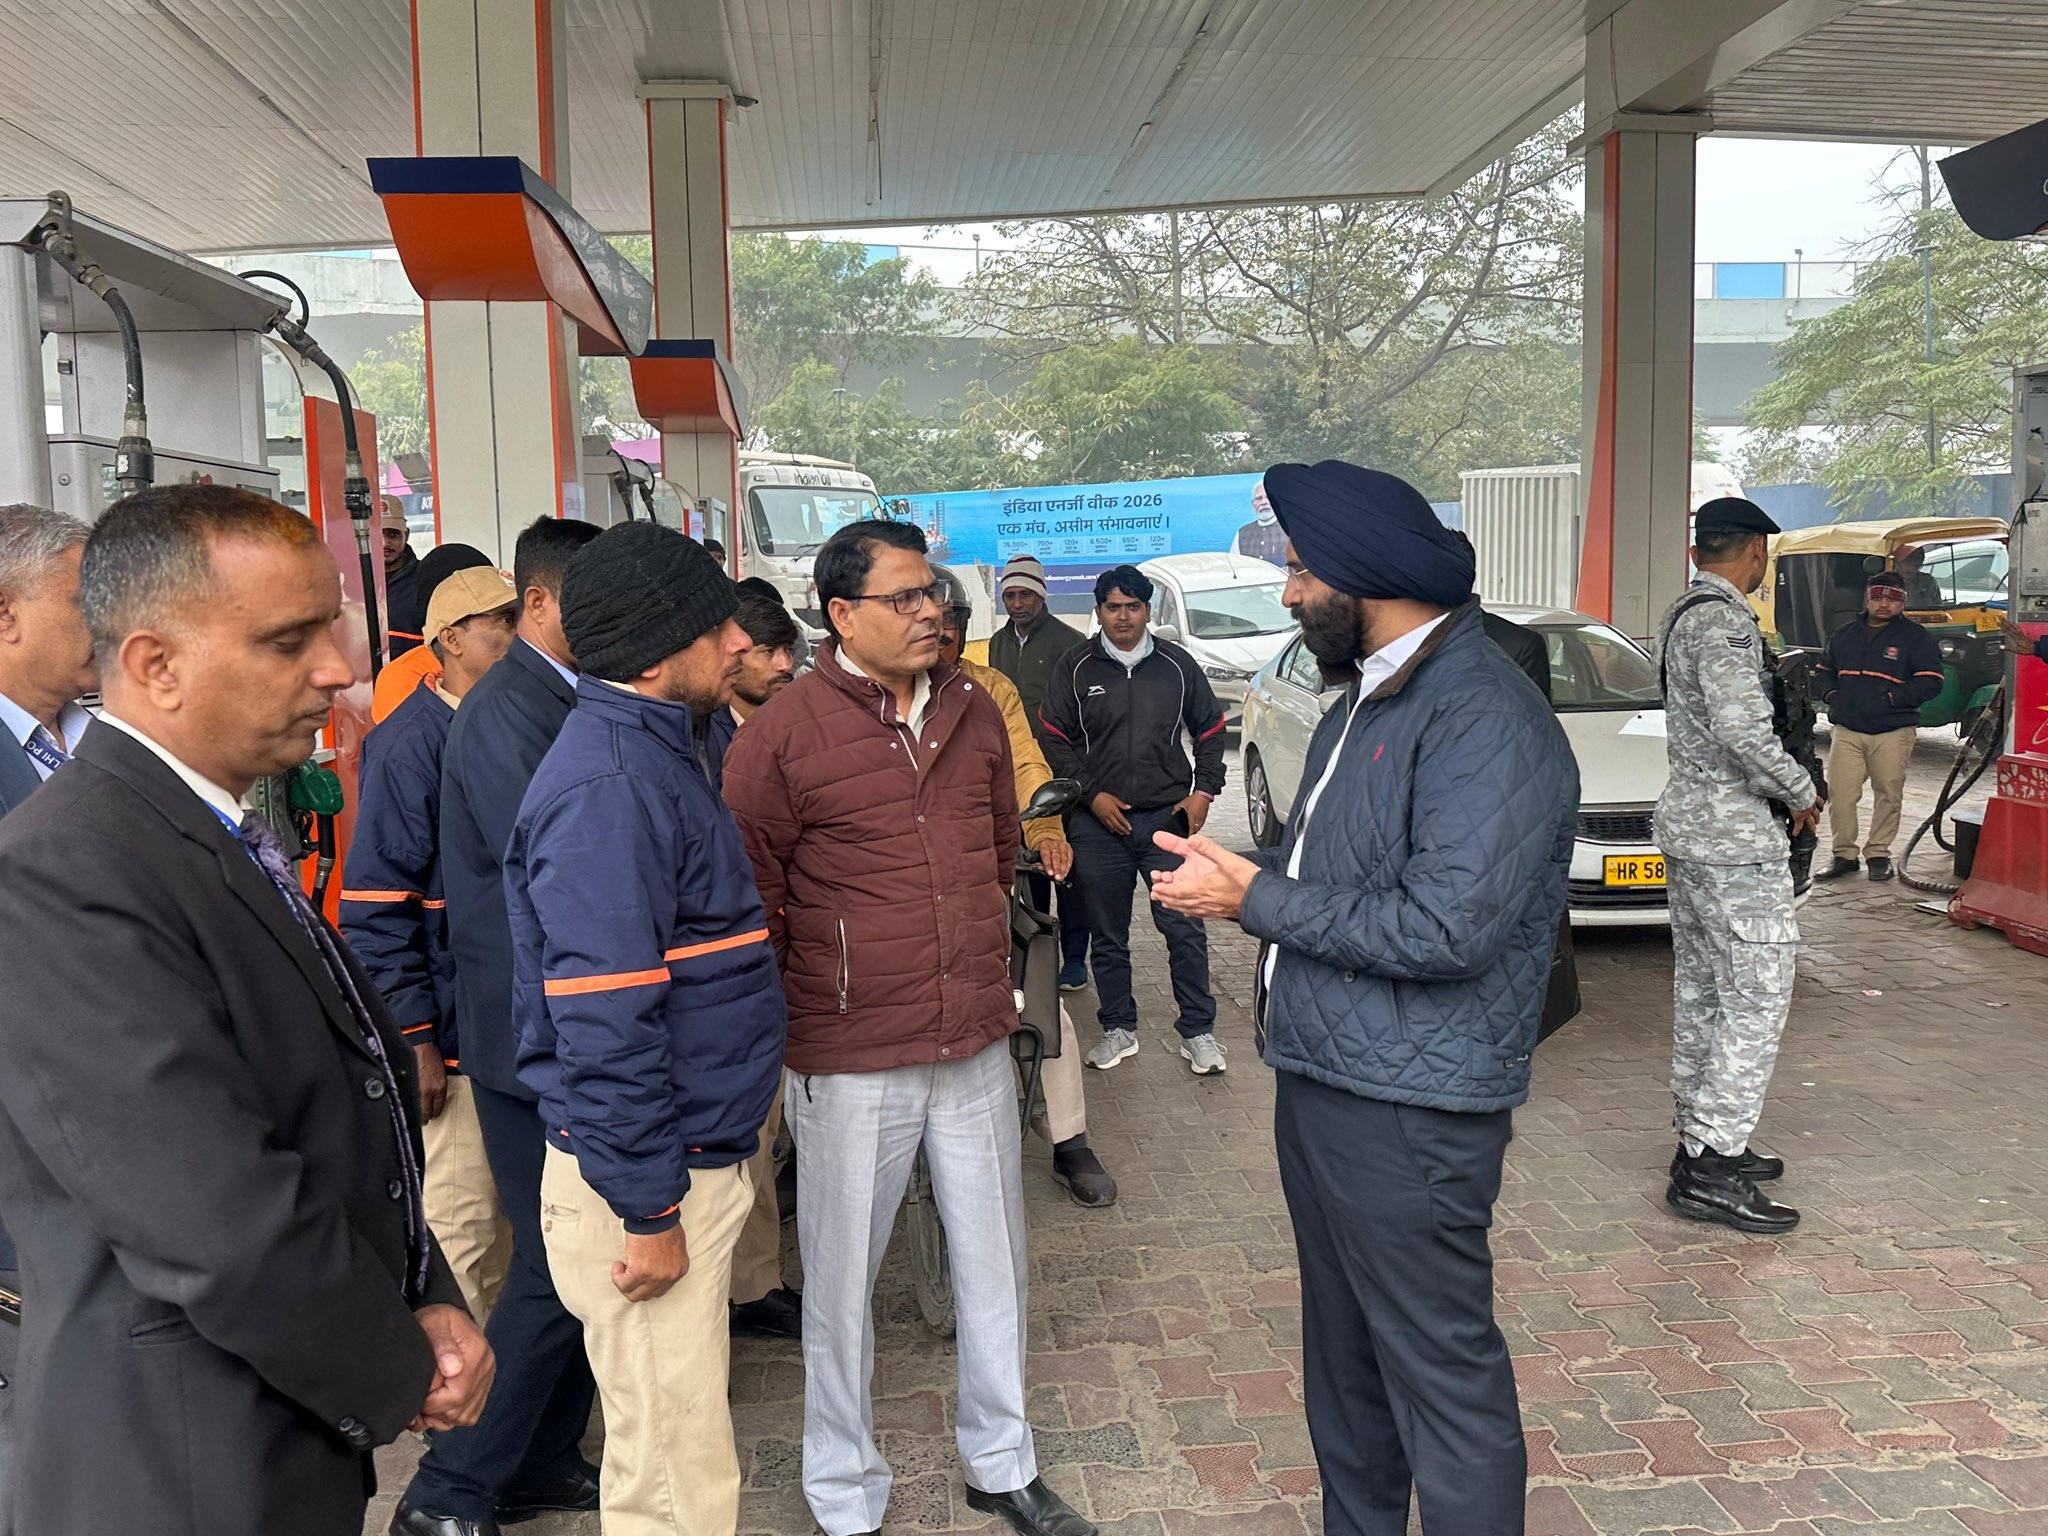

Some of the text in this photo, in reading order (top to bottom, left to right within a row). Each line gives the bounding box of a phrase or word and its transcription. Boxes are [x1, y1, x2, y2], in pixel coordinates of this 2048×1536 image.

[1003, 493, 1163, 517] इंडिया एनर्जी वीक 2026
[997, 522, 1021, 536] एक
[1025, 519, 1050, 536] मंच,
[1055, 517, 1093, 533] असीम
[26, 740, 61, 768] LHI PO
[1617, 861, 1665, 880] HR 58
